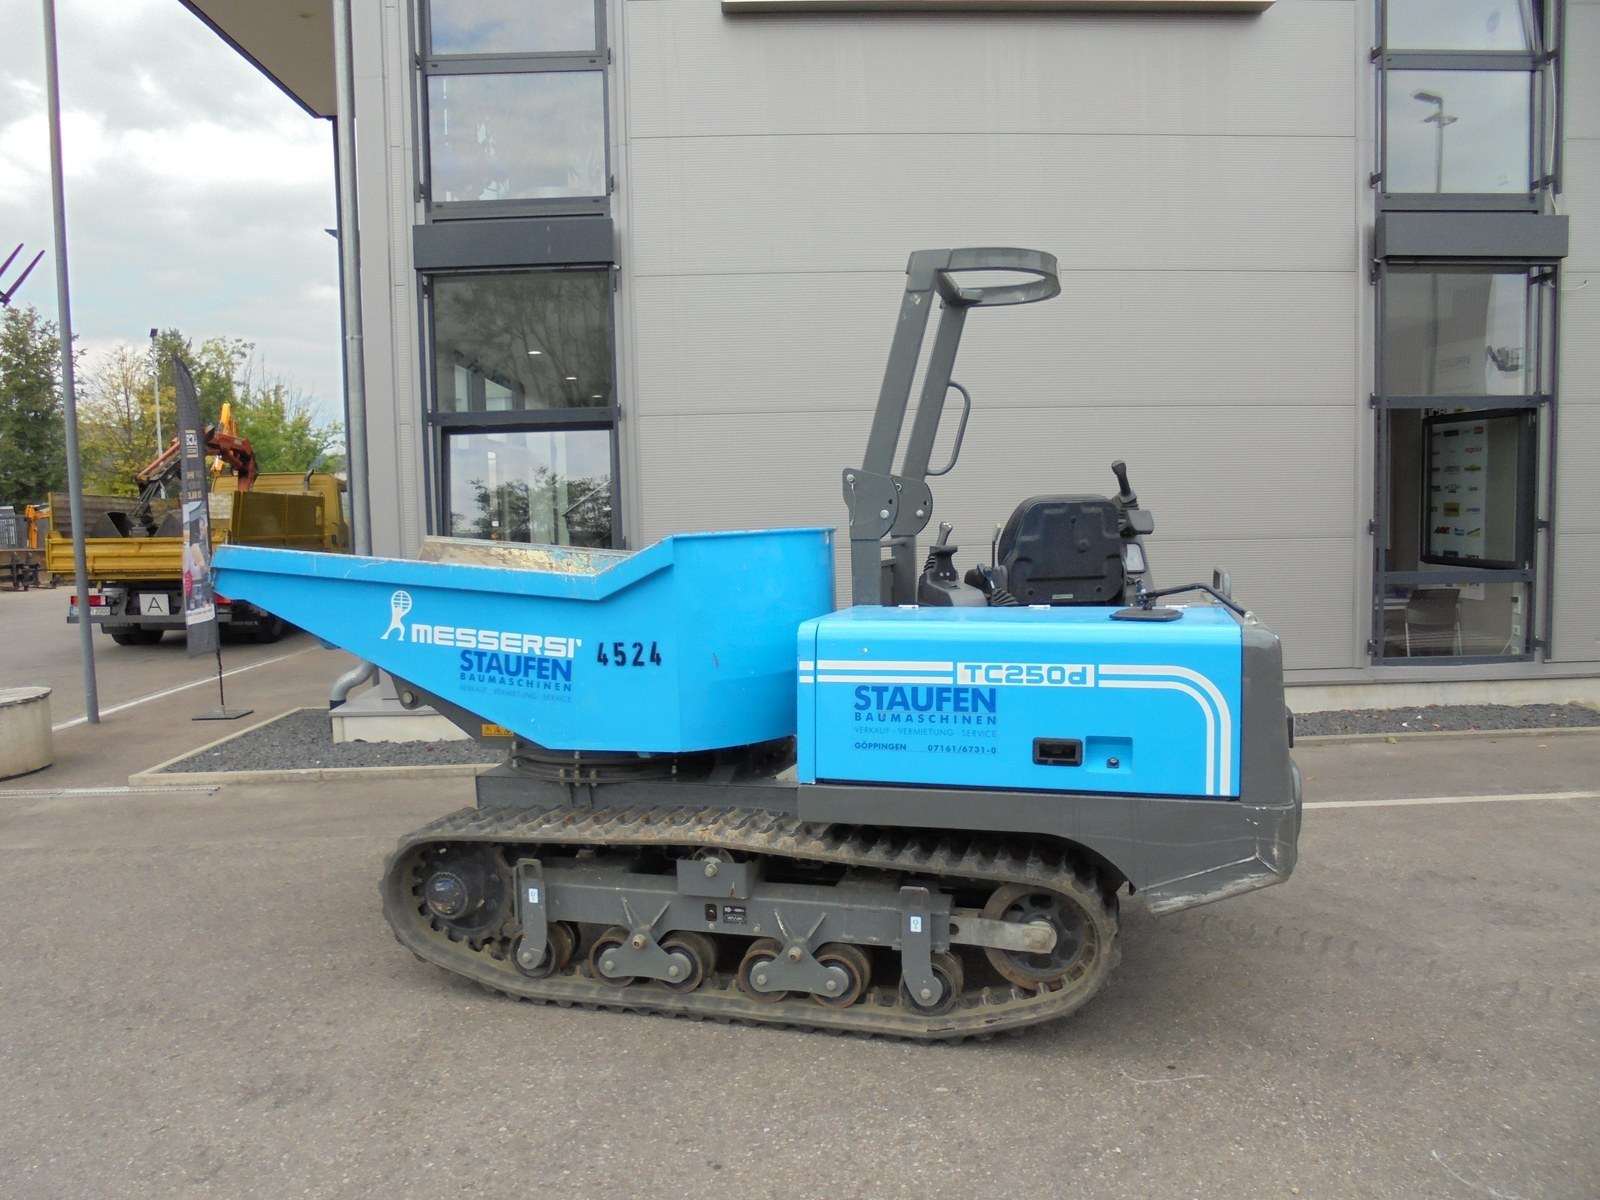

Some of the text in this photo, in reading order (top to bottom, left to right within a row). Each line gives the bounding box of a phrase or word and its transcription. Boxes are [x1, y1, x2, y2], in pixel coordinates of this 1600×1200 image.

[147, 596, 163, 613] A
[597, 641, 662, 666] 4524
[459, 649, 572, 682] STAUFEN
[964, 665, 1087, 685] TC250d
[460, 672, 572, 692] BAUMASCHINEN
[854, 685, 996, 713] STAUFEN
[854, 712, 996, 725] BAUMASCHINEN
[854, 726, 996, 738] VERKAUF VERMIETUNG SERVICE
[854, 741, 997, 754] GÖPPINGEN 07161/6731-0
